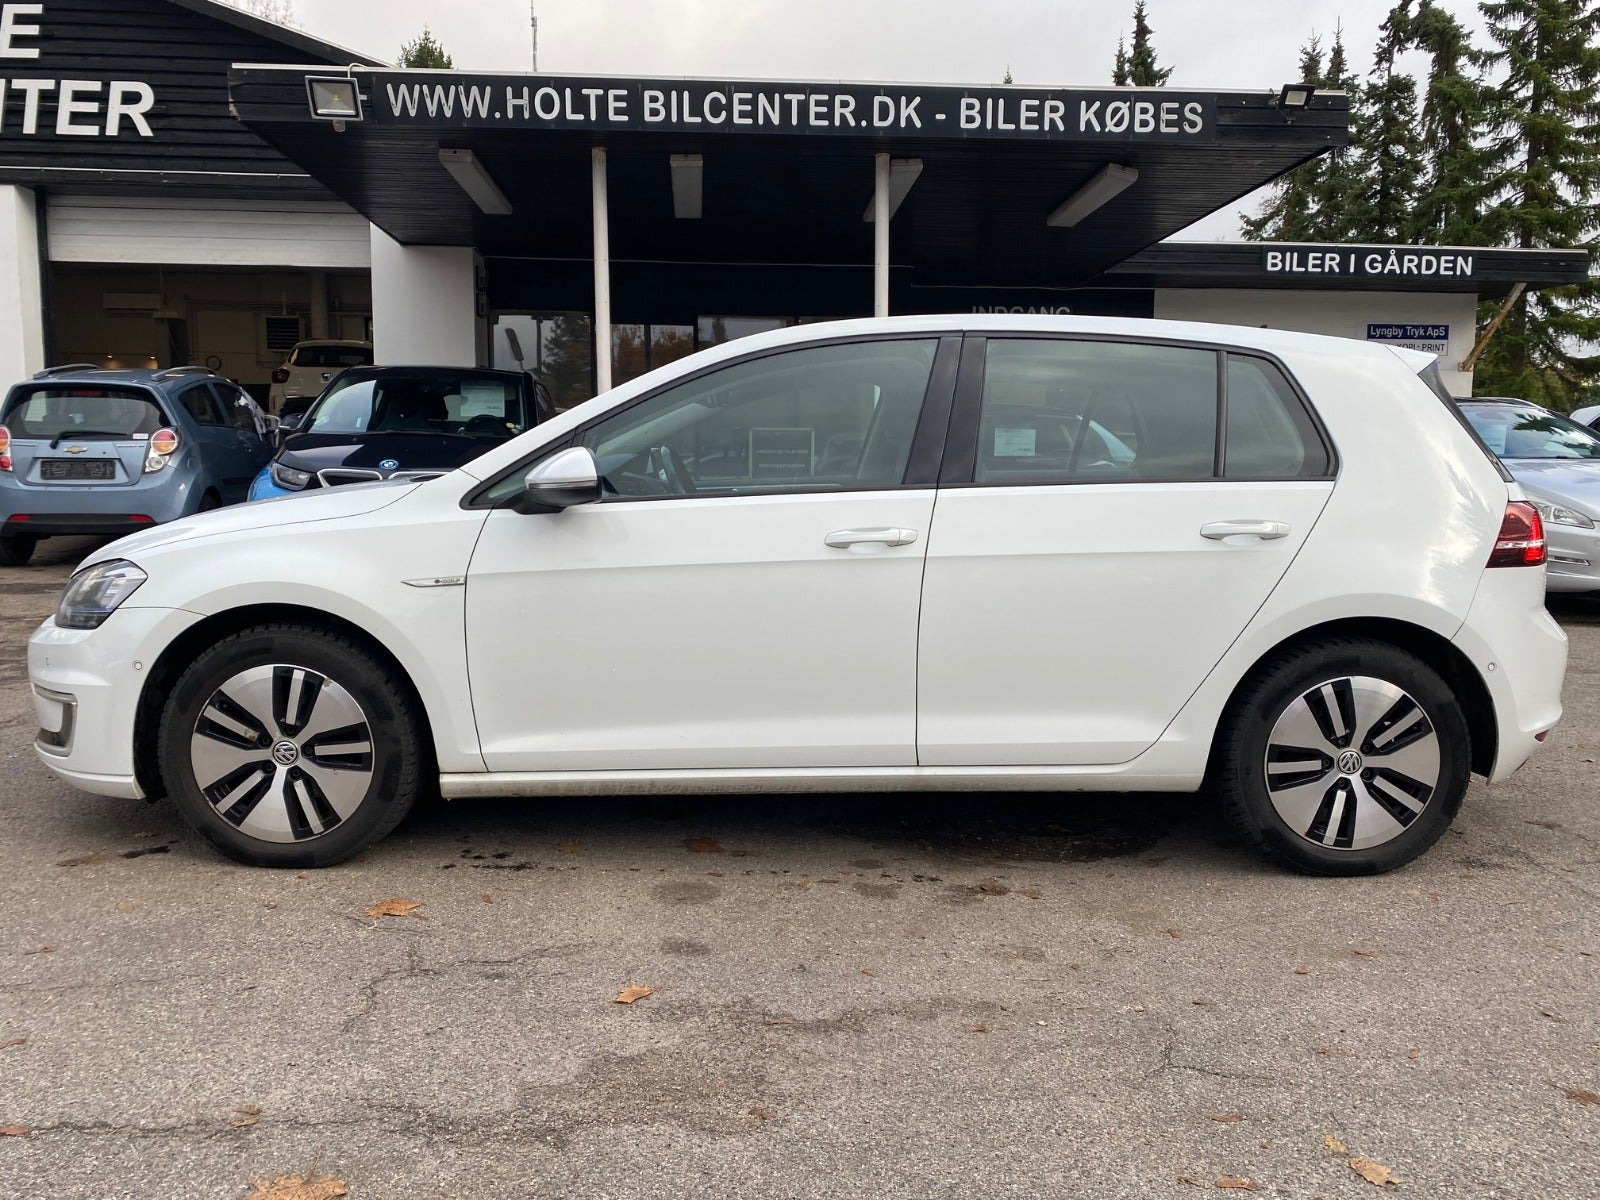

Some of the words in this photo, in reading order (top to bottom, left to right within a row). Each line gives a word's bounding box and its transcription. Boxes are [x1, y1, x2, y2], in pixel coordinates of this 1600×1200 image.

[386, 83, 629, 121] WWW.HOLTE
[643, 89, 922, 128] BILCENTER.DK
[960, 97, 1065, 132] BILER
[1079, 100, 1203, 133] KØBES
[1266, 251, 1340, 273] BILER
[1349, 253, 1355, 273] I
[1364, 249, 1473, 276] GÅRDEN
[1370, 326, 1404, 338] Lyngby
[1406, 326, 1425, 338] Tryk
[1426, 326, 1446, 338] ApS
[1421, 343, 1446, 352] PRINT
